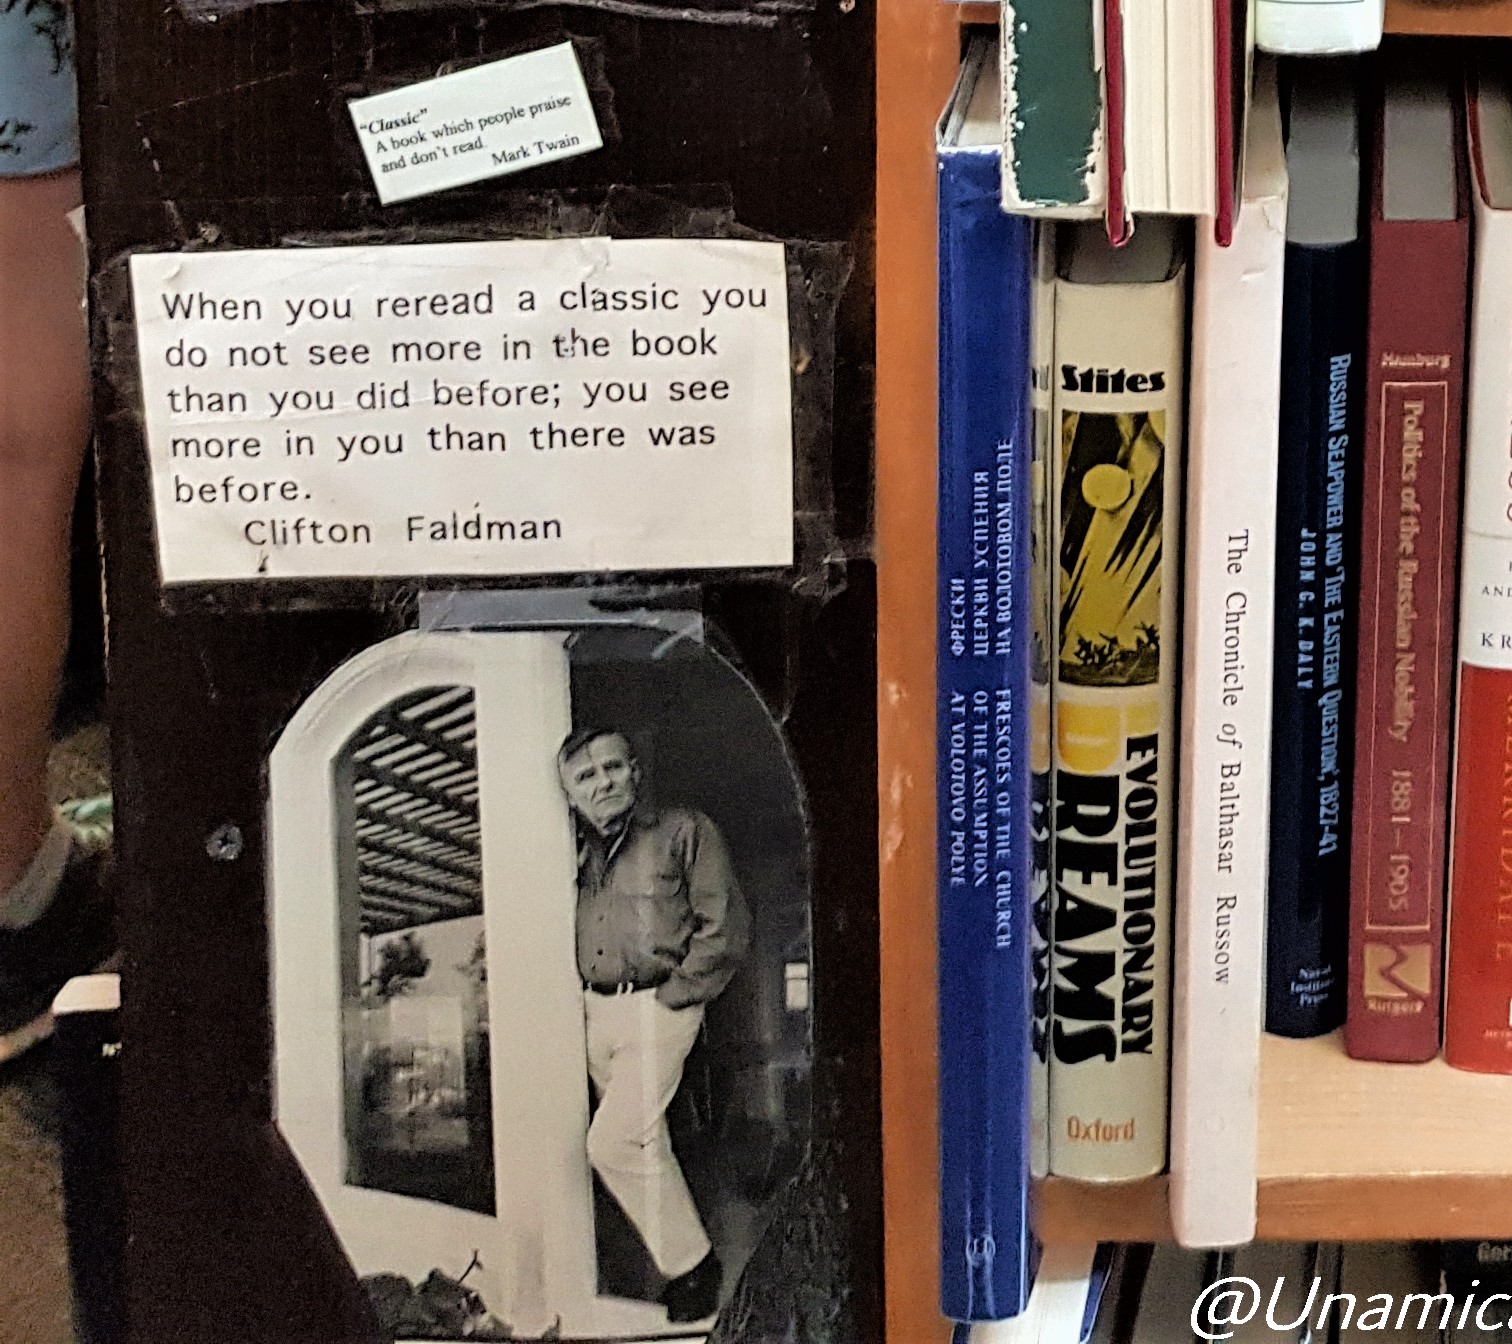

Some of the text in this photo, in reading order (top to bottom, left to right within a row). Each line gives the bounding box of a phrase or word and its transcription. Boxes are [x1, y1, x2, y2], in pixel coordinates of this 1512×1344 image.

[376, 95, 571, 154] A book which people praise
[492, 134, 580, 165] Mark Twain
[1061, 364, 1165, 394] Stites
[244, 516, 371, 546] Clifton
[1214, 528, 1249, 985] The Chronicle of Balthasar Russow
